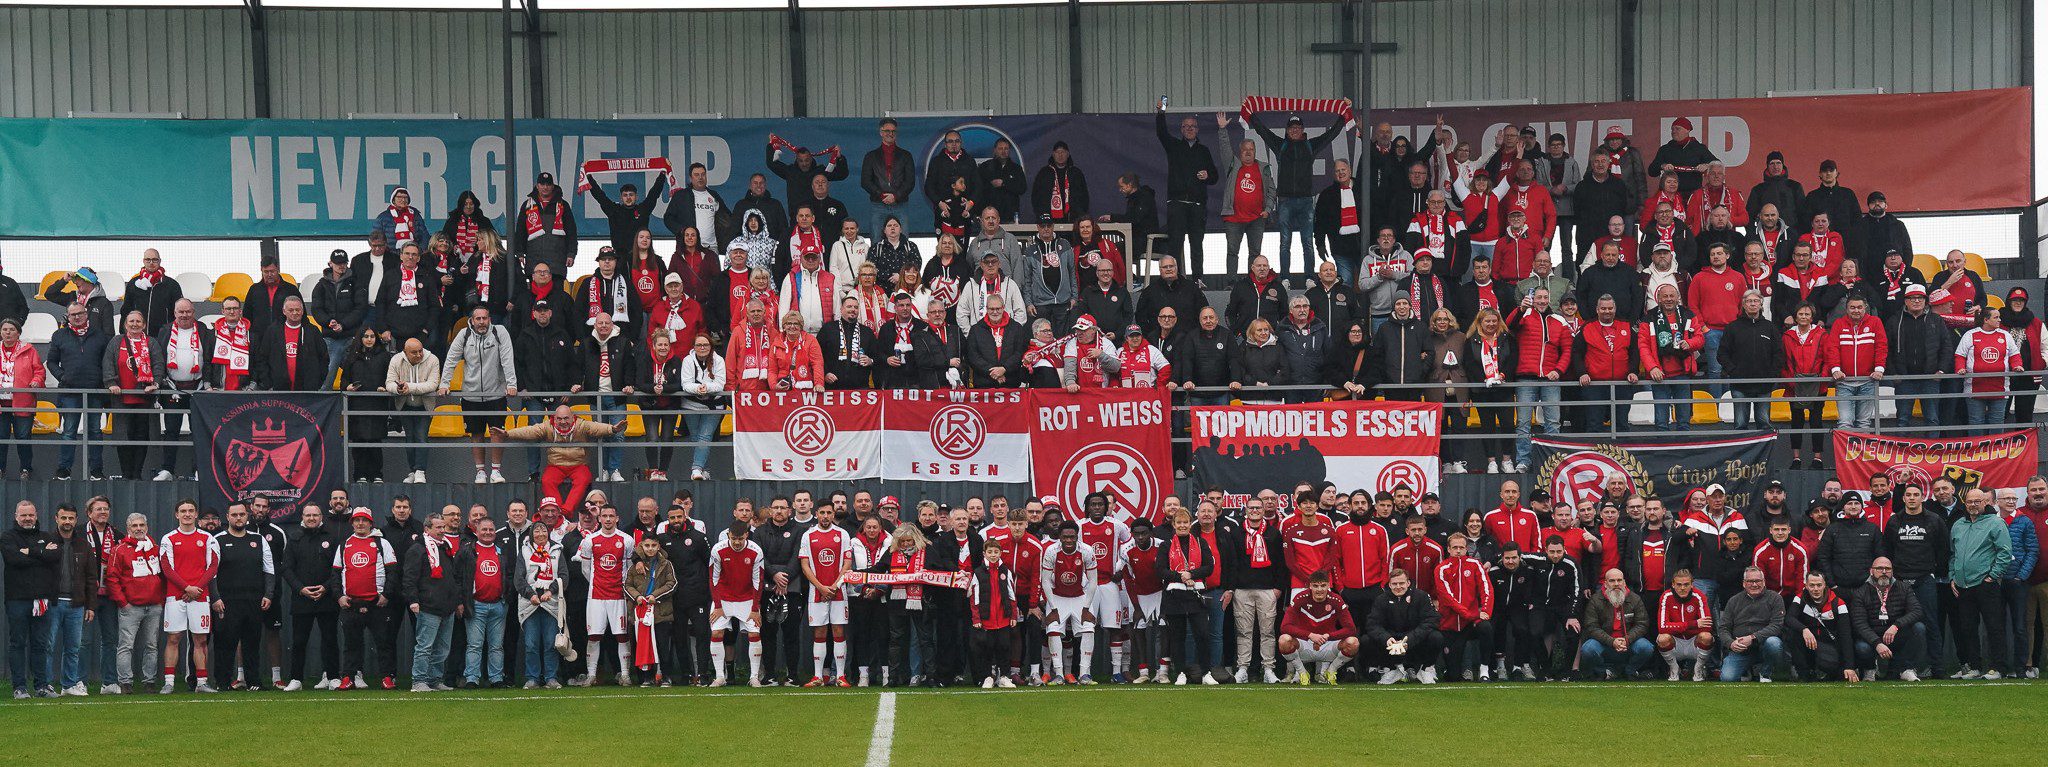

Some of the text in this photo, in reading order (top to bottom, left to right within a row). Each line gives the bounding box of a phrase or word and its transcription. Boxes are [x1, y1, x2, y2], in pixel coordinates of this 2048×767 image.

[607, 158, 650, 170] NUR DER RWE
[230, 136, 449, 220] NEVER
[1983, 347, 1998, 360] ifm
[740, 391, 878, 407] ROT-WEISS
[893, 389, 1021, 404] ROT-WEISS
[221, 400, 317, 424] ASSINDIA SUPPORTERS
[1039, 404, 1081, 431] ROT
[1098, 399, 1163, 428] WEISS
[1195, 409, 1437, 438] TOPMODELS ESSEN
[1845, 434, 2029, 465] DEUTSCHLAND
[762, 458, 859, 473] ESSEN
[912, 461, 999, 476] ESSEN
[1667, 459, 1768, 485] Crazy Boys
[271, 503, 296, 519] 2009
[820, 549, 834, 562] ifm
[920, 572, 951, 584] POTT
[200, 615, 210, 628] 38
